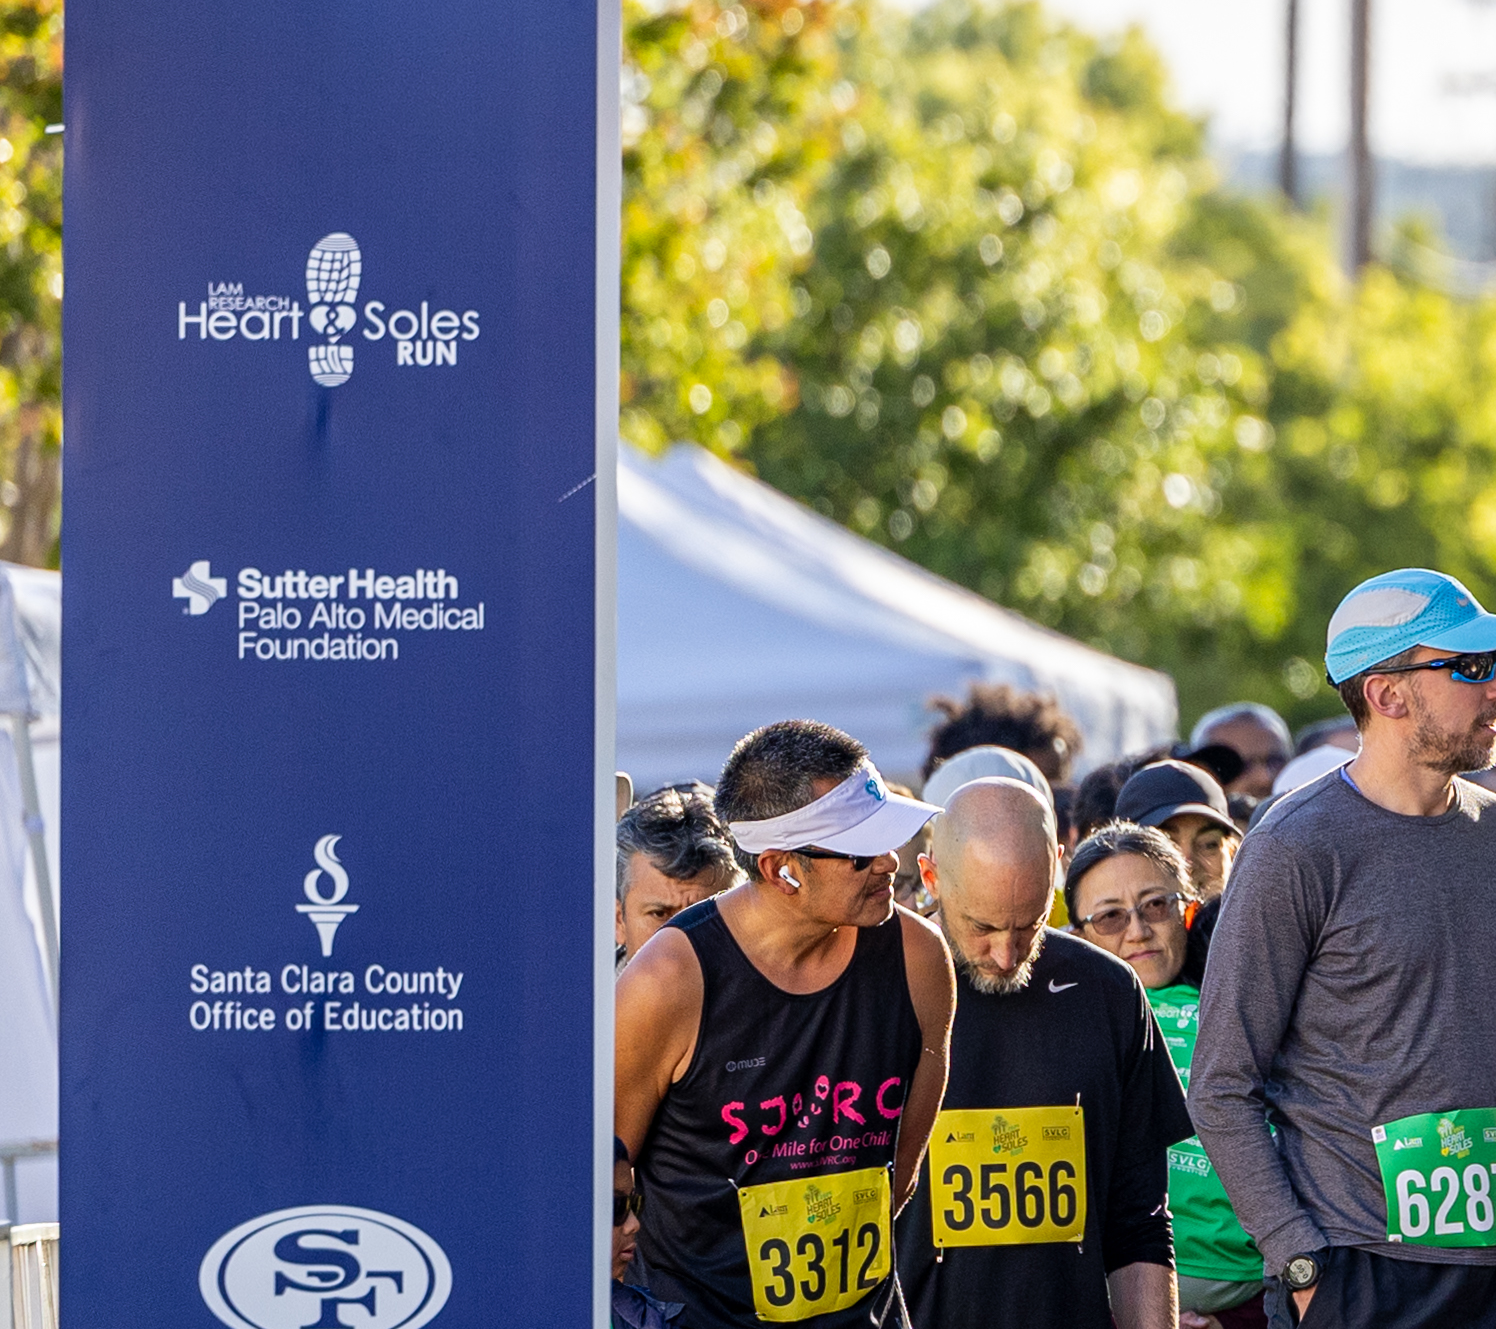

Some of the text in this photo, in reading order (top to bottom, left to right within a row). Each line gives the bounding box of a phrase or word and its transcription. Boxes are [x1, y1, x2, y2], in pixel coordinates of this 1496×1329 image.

[208, 282, 243, 296] LAM
[208, 296, 290, 311] RESEARCH
[178, 302, 304, 340] Heart
[363, 301, 480, 341] Soles
[396, 341, 457, 366] RUN
[237, 568, 458, 600] Sutter Health
[238, 602, 485, 630] Palo Alto Medical
[238, 633, 399, 660] Foundation
[190, 964, 464, 1000] Santa Clara County
[189, 1001, 464, 1032] Office of Education
[829, 1134, 860, 1151] One
[943, 1160, 1077, 1231] 3566
[760, 1222, 881, 1307] 3312
